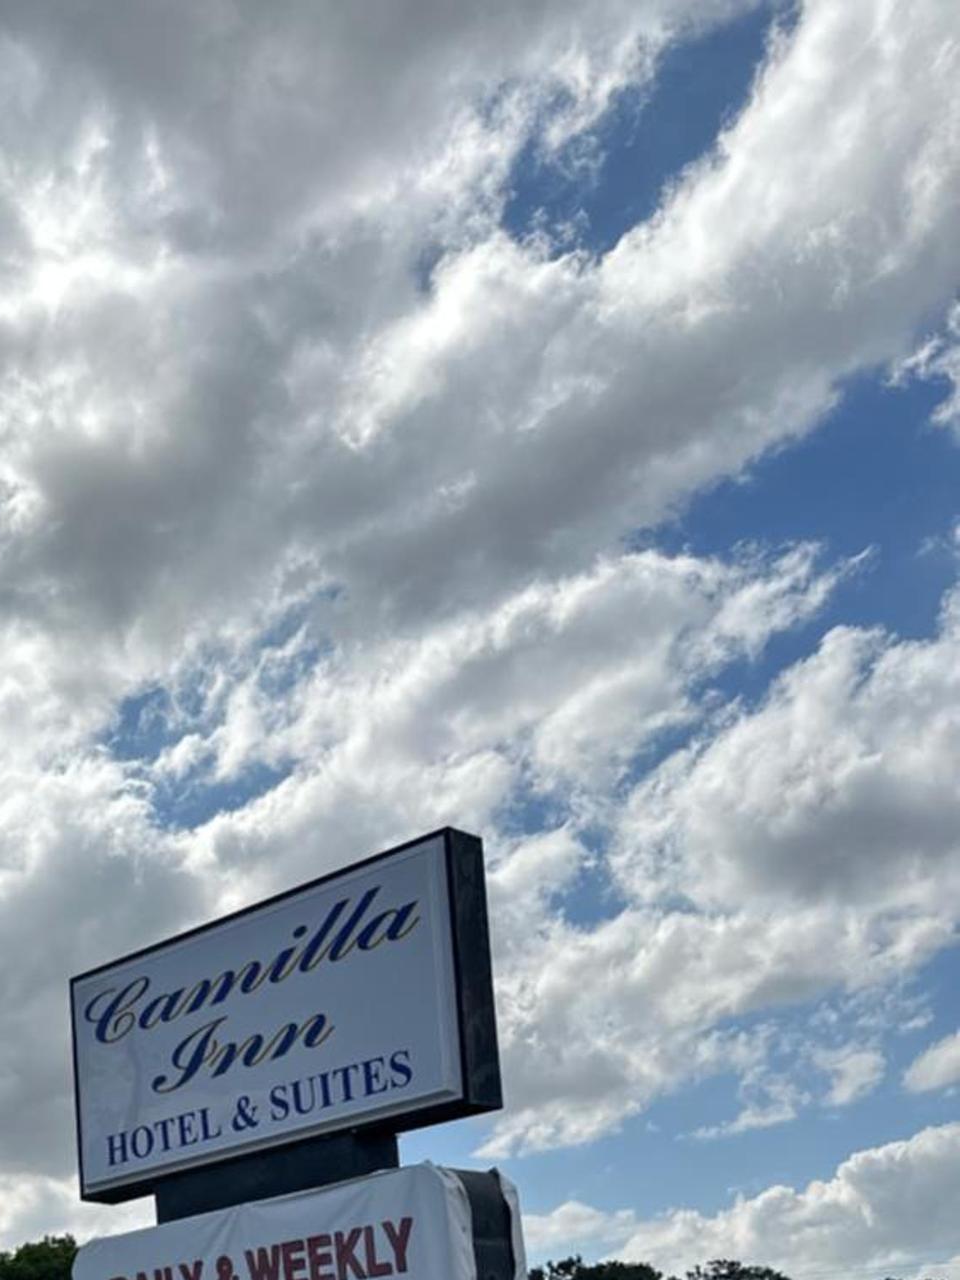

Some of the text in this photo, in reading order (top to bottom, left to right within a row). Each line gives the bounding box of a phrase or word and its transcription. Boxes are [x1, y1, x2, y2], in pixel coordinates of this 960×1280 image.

[84, 885, 420, 1044] Camilla
[107, 1049, 414, 1167] HOTEL & SUITES
[151, 1011, 335, 1094] Inn
